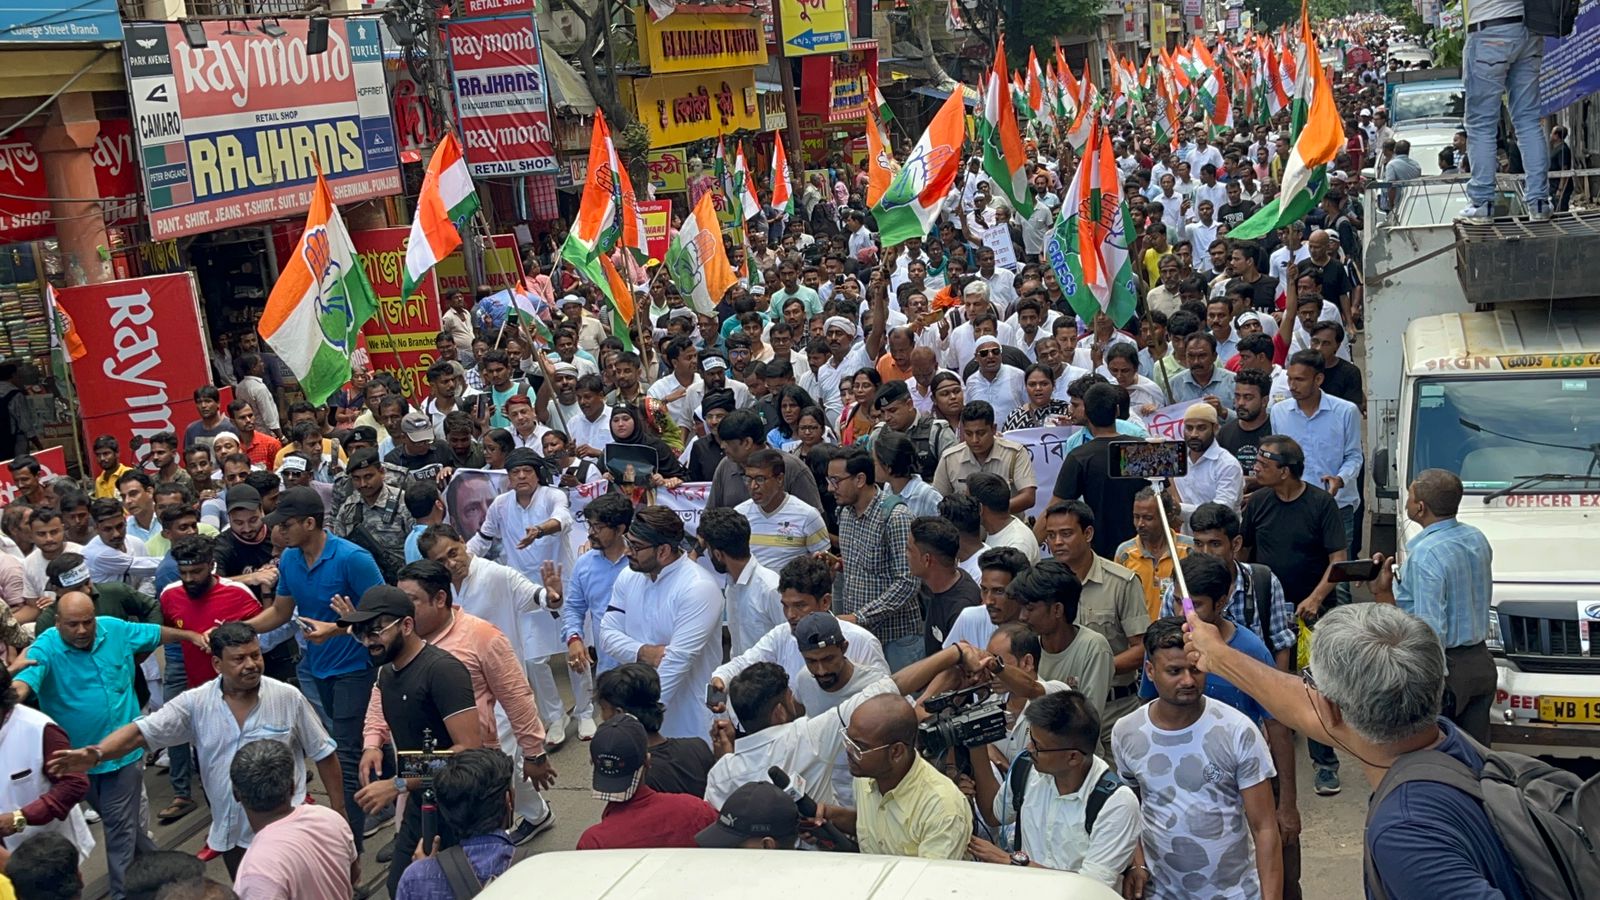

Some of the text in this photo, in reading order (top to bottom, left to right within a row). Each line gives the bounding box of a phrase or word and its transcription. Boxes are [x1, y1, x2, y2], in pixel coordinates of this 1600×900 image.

[10, 24, 99, 38] College Street Branch
[350, 44, 379, 56] TURTLE
[452, 27, 534, 60] Raymond
[130, 53, 170, 66] PARK AVENUE
[457, 73, 539, 96] RAJHANS
[255, 110, 298, 122] RETAIL SHOP
[140, 111, 181, 139] CAMARO
[464, 120, 550, 153] Raymond
[188, 120, 364, 197] RAJHANS
[475, 159, 551, 174] RETAIL SHOP
[150, 168, 187, 182] PETER ENGLAND
[157, 216, 183, 235] PANT.
[185, 210, 213, 229] SHIRT.
[214, 204, 244, 223] JEANS.
[244, 196, 277, 216] T-SHIRT.
[278, 194, 299, 210] SUIT.
[333, 179, 372, 199] SHERWANI.
[371, 175, 400, 193] PUNJABI
[12, 211, 51, 229] SHOP
[369, 340, 379, 349] We
[397, 338, 407, 347] No
[408, 336, 437, 347] Branches
[1508, 356, 1543, 368] GOODS
[1506, 494, 1572, 507] OFFICER
[1554, 702, 1576, 718] WB
